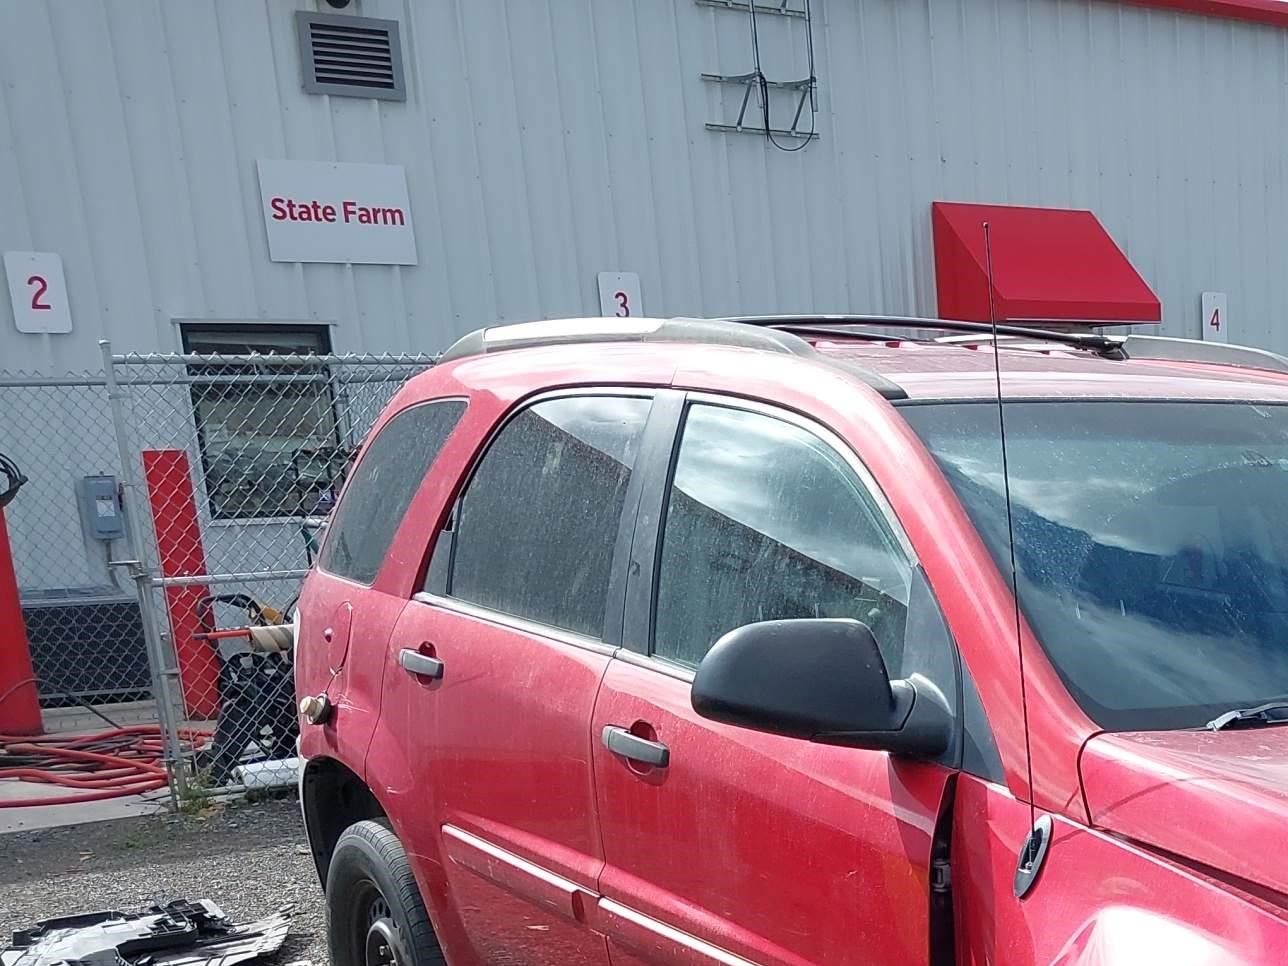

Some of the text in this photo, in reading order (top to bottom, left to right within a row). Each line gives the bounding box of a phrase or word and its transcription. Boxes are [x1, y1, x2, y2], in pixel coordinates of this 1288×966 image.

[271, 198, 405, 226] State Farm
[27, 275, 51, 310] 2
[614, 291, 630, 317] 3
[1210, 308, 1220, 332] 4
